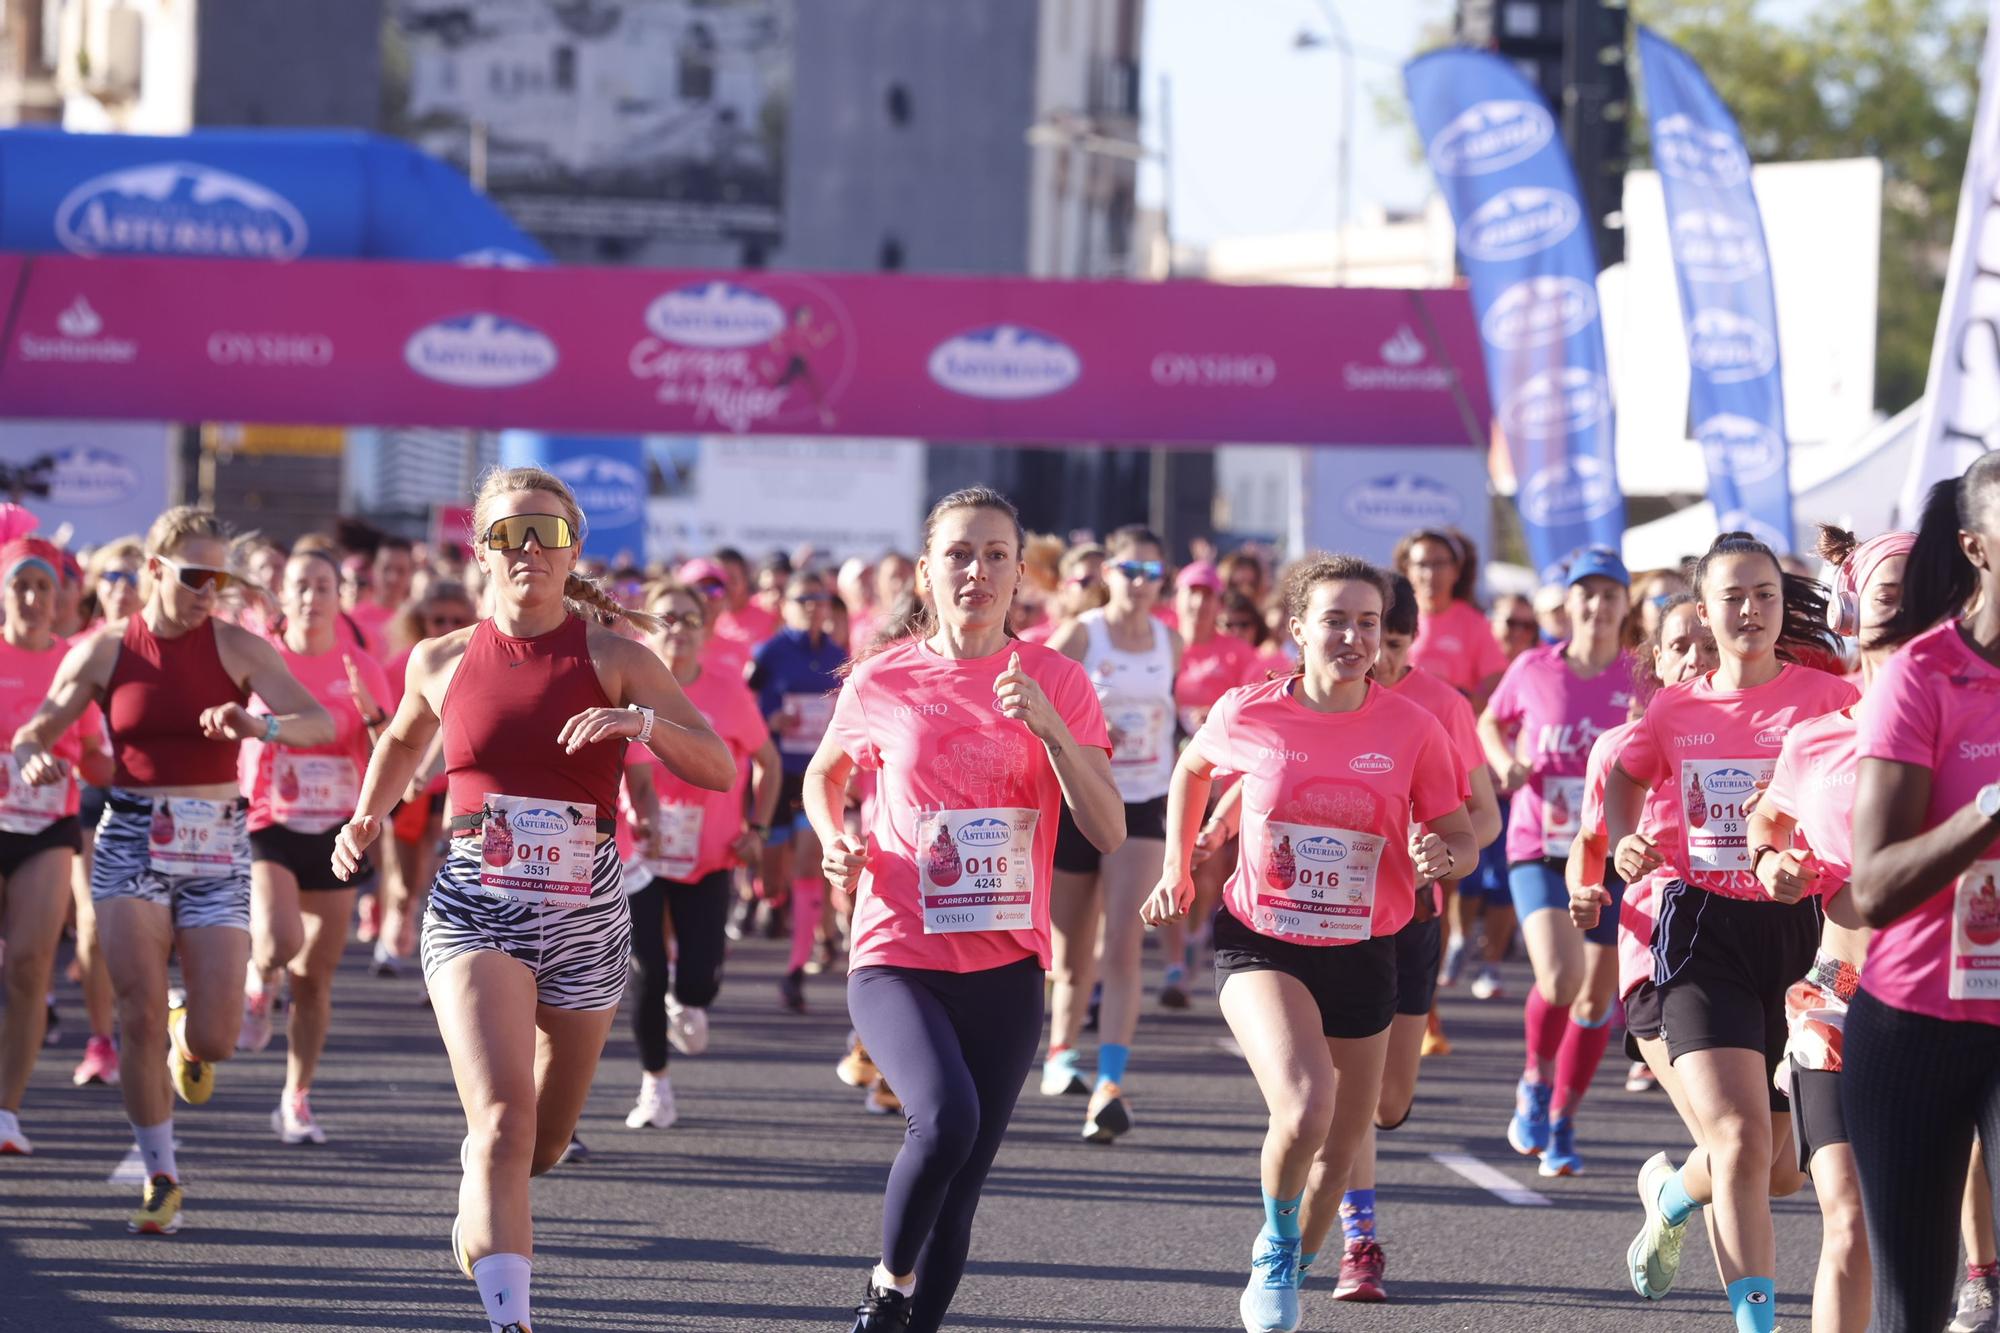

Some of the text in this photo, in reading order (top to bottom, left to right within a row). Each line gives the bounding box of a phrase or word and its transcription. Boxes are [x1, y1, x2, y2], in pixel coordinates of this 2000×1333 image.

[207, 330, 335, 367] OYSHO
[1151, 352, 1277, 387] OYSHO
[893, 702, 948, 719] OYSHO
[1258, 748, 1308, 763] OYSHO
[1708, 778, 1753, 789] ASTURIANA
[517, 816, 564, 831] ASTURIANA
[1723, 822, 1738, 833] 93
[517, 843, 561, 863] 016
[1300, 844, 1344, 857] ASTURIANA
[1351, 845, 1374, 853] SUMA
[523, 864, 551, 877] 3531
[965, 856, 1008, 875] 016
[486, 877, 520, 887] CARRERA
[544, 883, 570, 892] MUJER
[974, 877, 1002, 889] 4243
[1299, 869, 1339, 887] 016
[1311, 889, 1324, 899] 94
[551, 899, 589, 909] Santander
[937, 897, 973, 905] CARRERA
[1269, 898, 1301, 909] CARRERA
[1302, 903, 1312, 911] DE
[1324, 906, 1347, 914] MUJER
[936, 912, 975, 924] OYSHO
[1264, 912, 1300, 926] OYSHO
[1328, 921, 1363, 930] Santander
